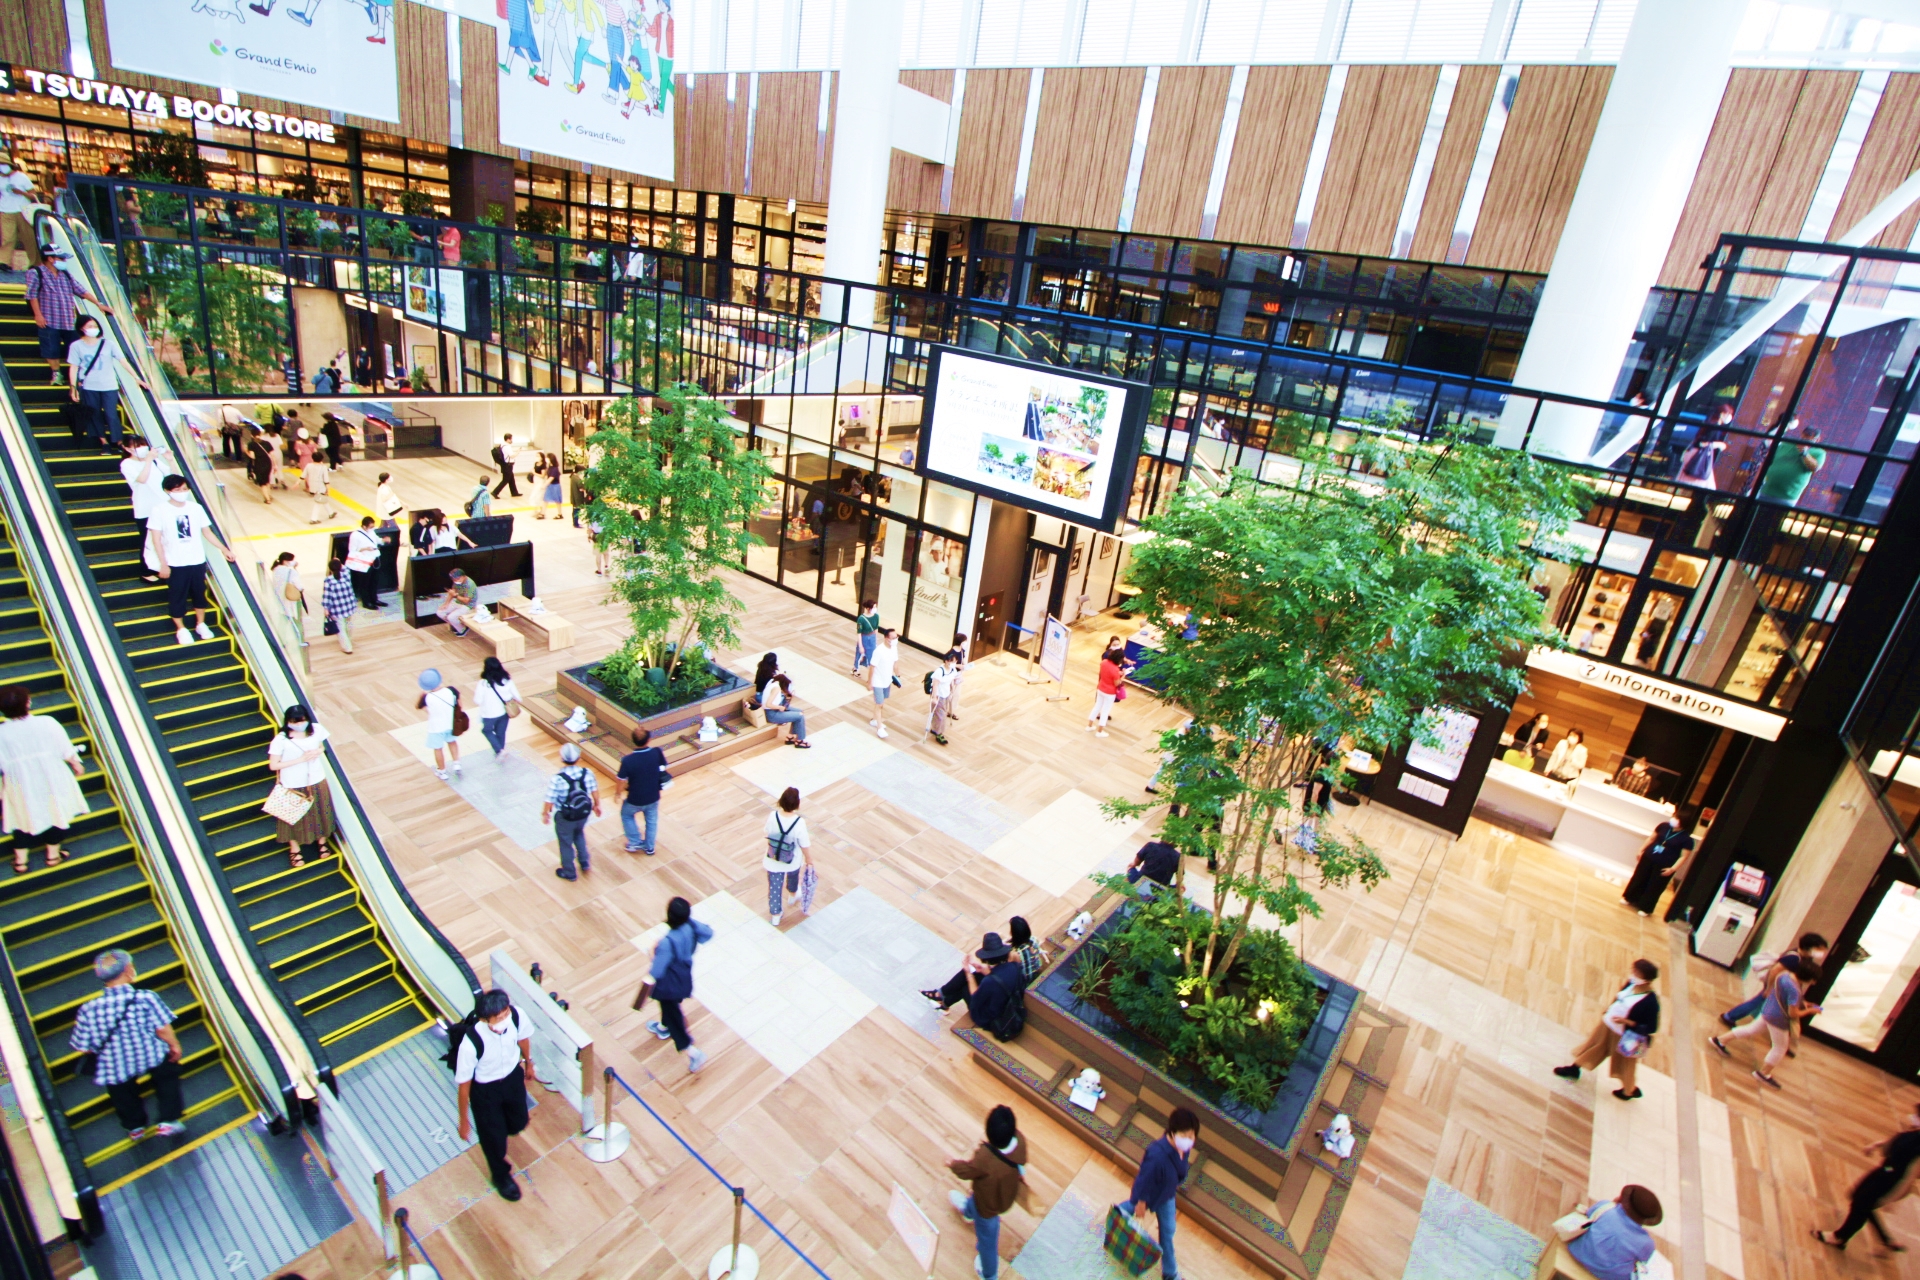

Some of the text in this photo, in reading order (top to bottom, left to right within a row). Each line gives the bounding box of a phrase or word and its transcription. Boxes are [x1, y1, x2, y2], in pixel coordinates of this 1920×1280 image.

[235, 47, 281, 68] Grand
[284, 58, 317, 75] Emio
[25, 69, 336, 144] TSUTAYA BOOKSTORE
[575, 125, 604, 140] Grand
[605, 132, 626, 145] Emio
[1604, 670, 1725, 717] information
